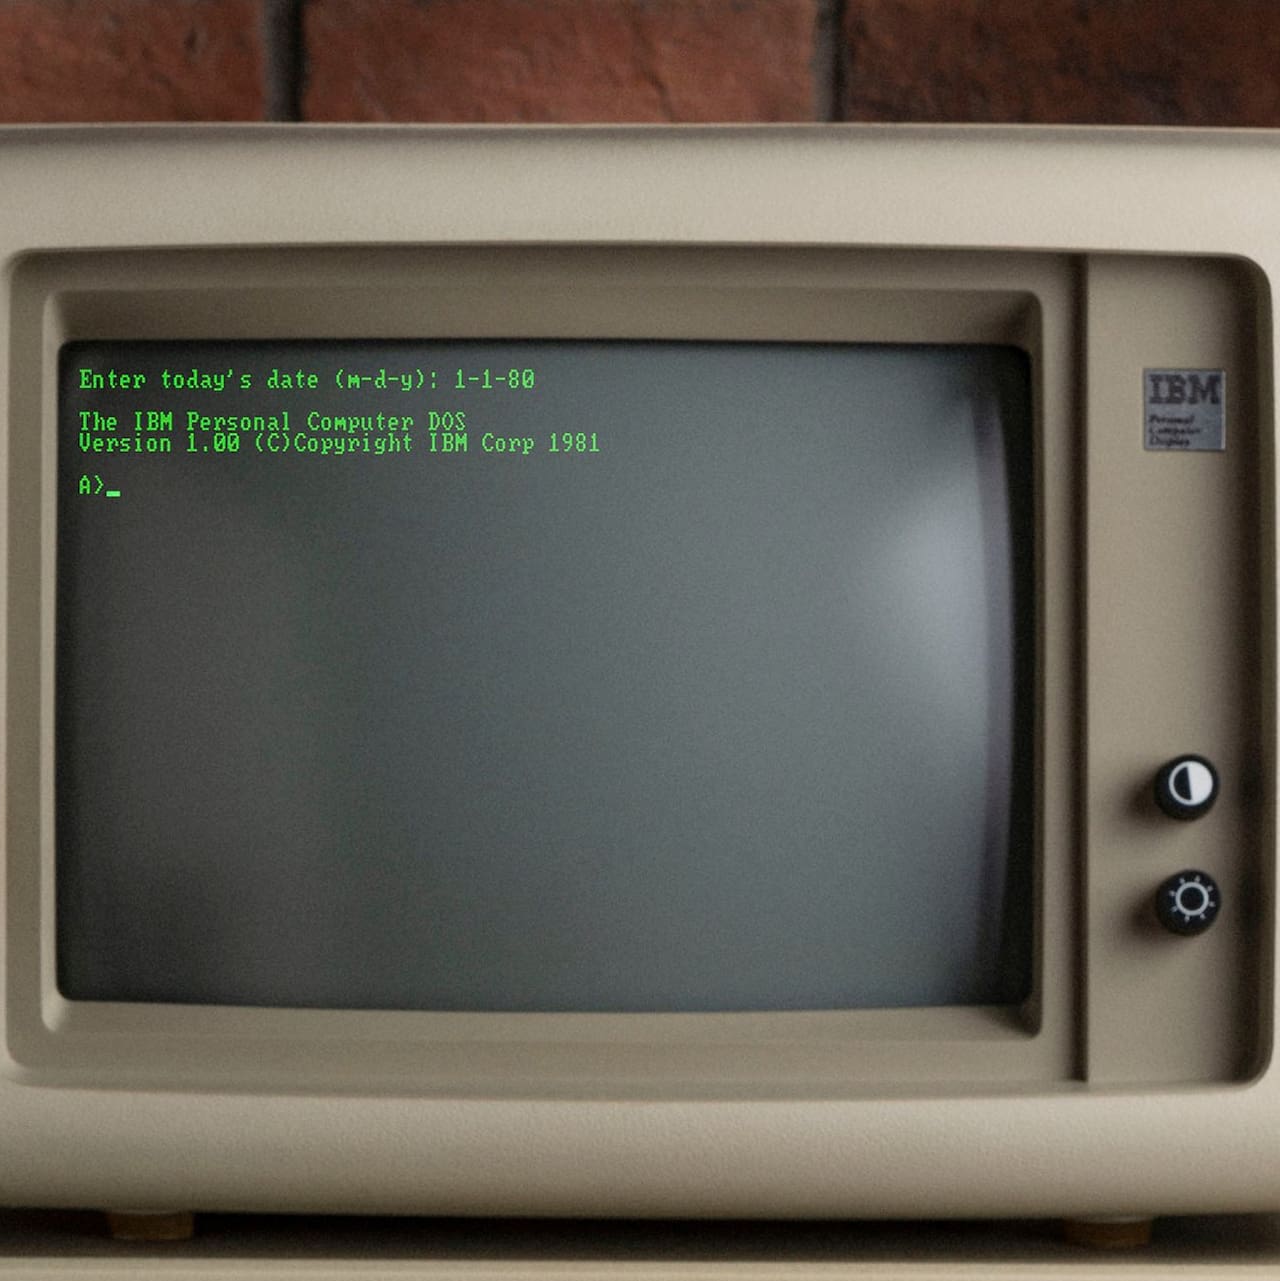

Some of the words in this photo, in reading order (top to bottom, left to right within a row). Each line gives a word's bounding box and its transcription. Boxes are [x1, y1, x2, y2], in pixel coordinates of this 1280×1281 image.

[79, 369, 147, 390] Enter
[161, 369, 252, 391] today's
[267, 369, 318, 388] date
[336, 369, 435, 391] (m-d-y):
[454, 369, 535, 389] 1-1-80
[1148, 373, 1221, 405] IBM
[79, 411, 118, 431] The
[134, 411, 173, 431] IBM
[187, 411, 290, 431] Personal
[307, 411, 414, 435] Computer
[428, 411, 466, 431] DOS
[79, 433, 172, 452] Version
[186, 433, 240, 452] 1.00
[255, 433, 413, 455] (C)Copyright
[429, 433, 468, 452] IBM
[482, 434, 534, 455] Corp
[548, 433, 600, 452] 1981
